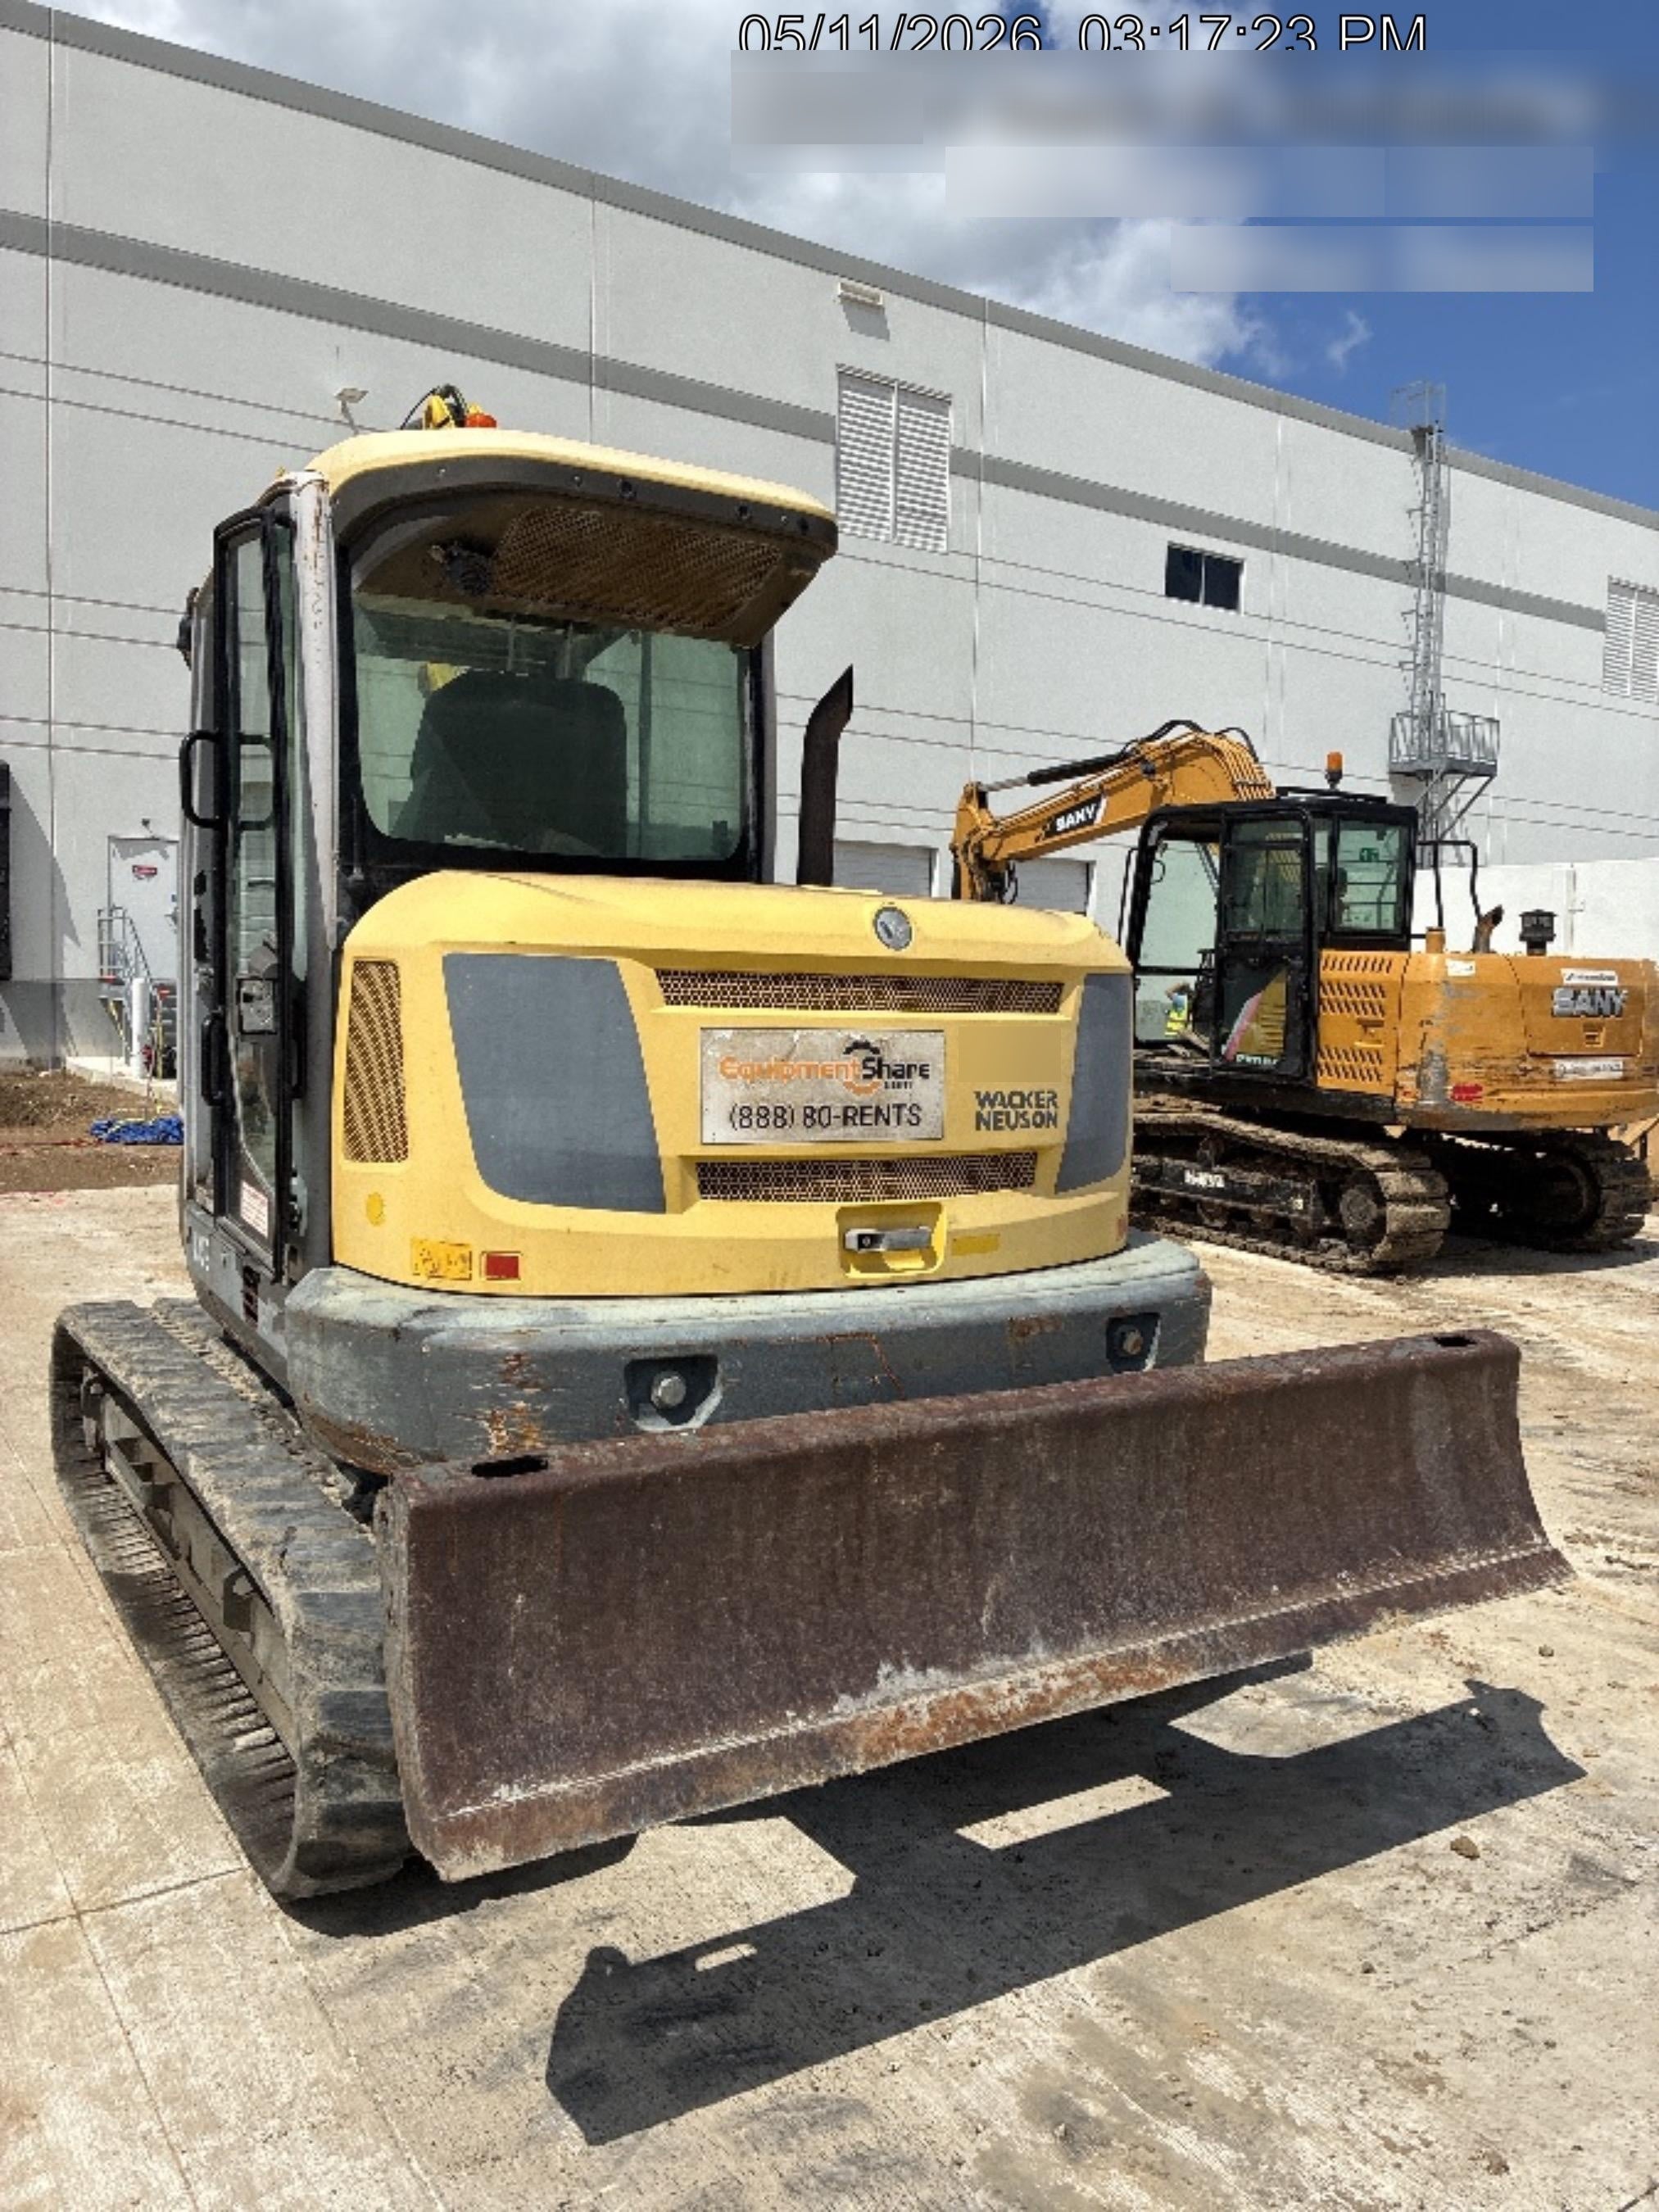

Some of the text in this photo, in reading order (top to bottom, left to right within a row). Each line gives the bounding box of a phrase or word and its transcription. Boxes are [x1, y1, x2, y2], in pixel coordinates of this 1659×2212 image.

[1056, 804, 1096, 832] SANY
[1551, 986, 1627, 1018] SANY
[719, 1056, 930, 1084] EquipmentShare
[974, 1090, 1058, 1109] WACKER
[730, 1103, 922, 1130] (888) 80-RENTS
[975, 1110, 1058, 1131] NEUSON
